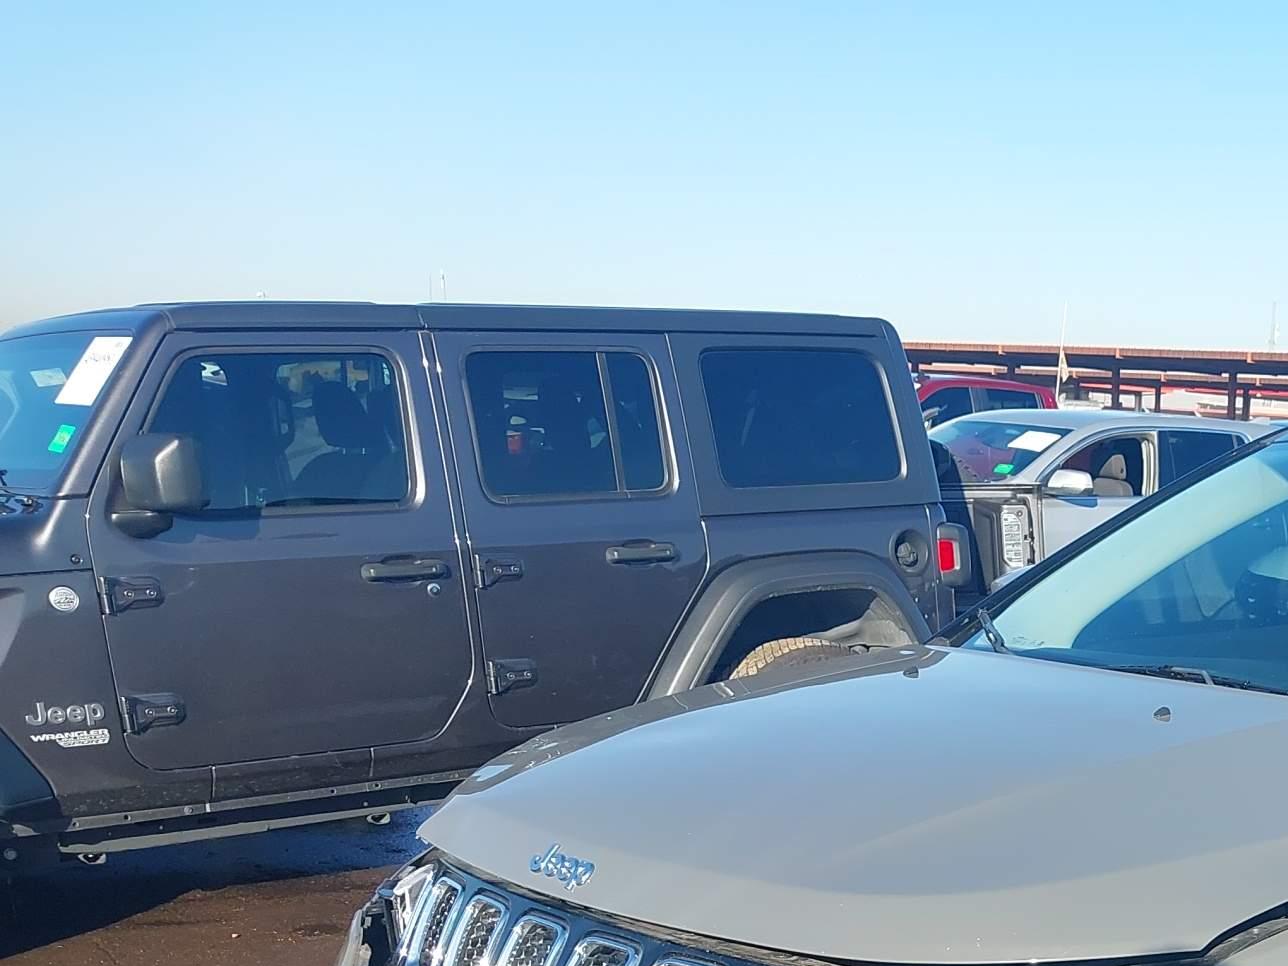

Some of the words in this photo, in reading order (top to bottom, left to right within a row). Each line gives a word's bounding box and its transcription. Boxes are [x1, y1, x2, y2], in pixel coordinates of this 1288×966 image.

[25, 702, 105, 726] Jeep
[30, 728, 108, 742] WRANGLER
[530, 844, 595, 892] Jeep
